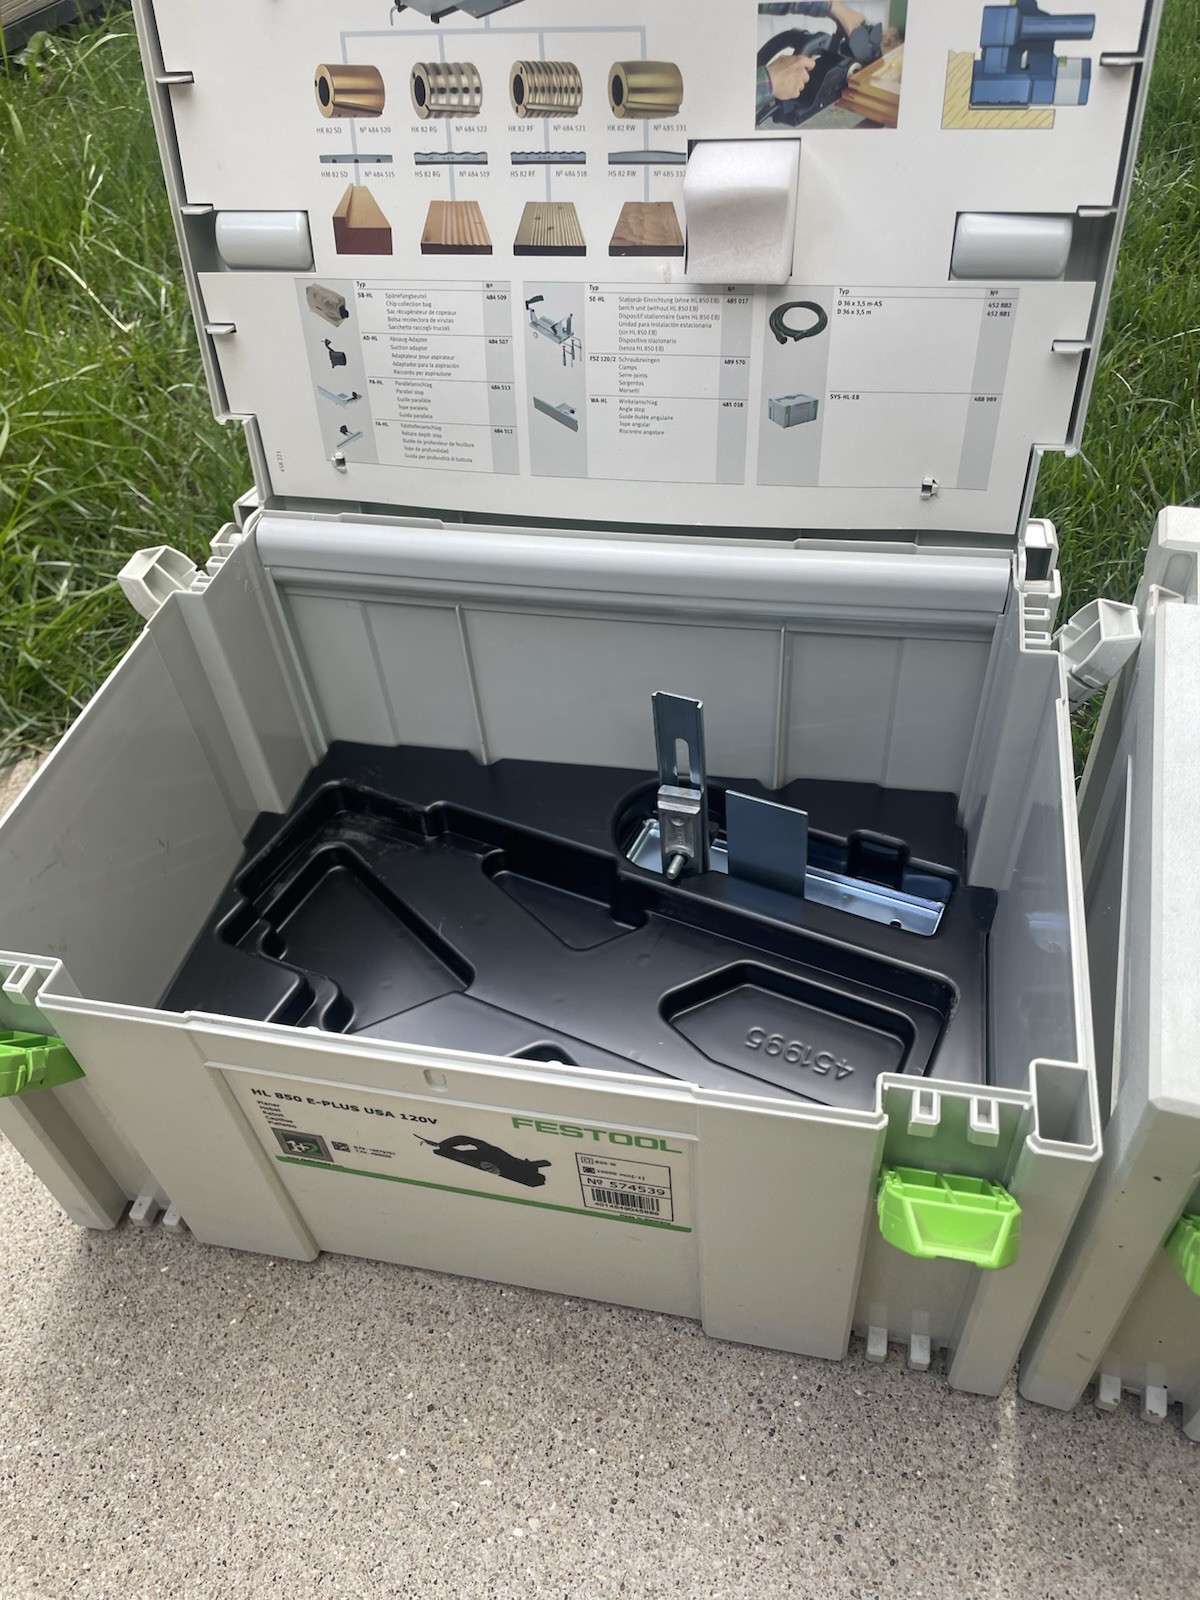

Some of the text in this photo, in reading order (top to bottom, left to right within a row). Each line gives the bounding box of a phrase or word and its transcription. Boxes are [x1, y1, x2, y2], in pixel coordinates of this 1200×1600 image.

[663, 124, 687, 132] 485 331
[839, 288, 850, 296] Typ
[744, 1025, 856, 1081] 451995
[251, 1088, 438, 1125] HL 850 E-PLUS USA 120V
[511, 1117, 683, 1155] FESTOOL
[610, 1181, 665, 1196] 574539
